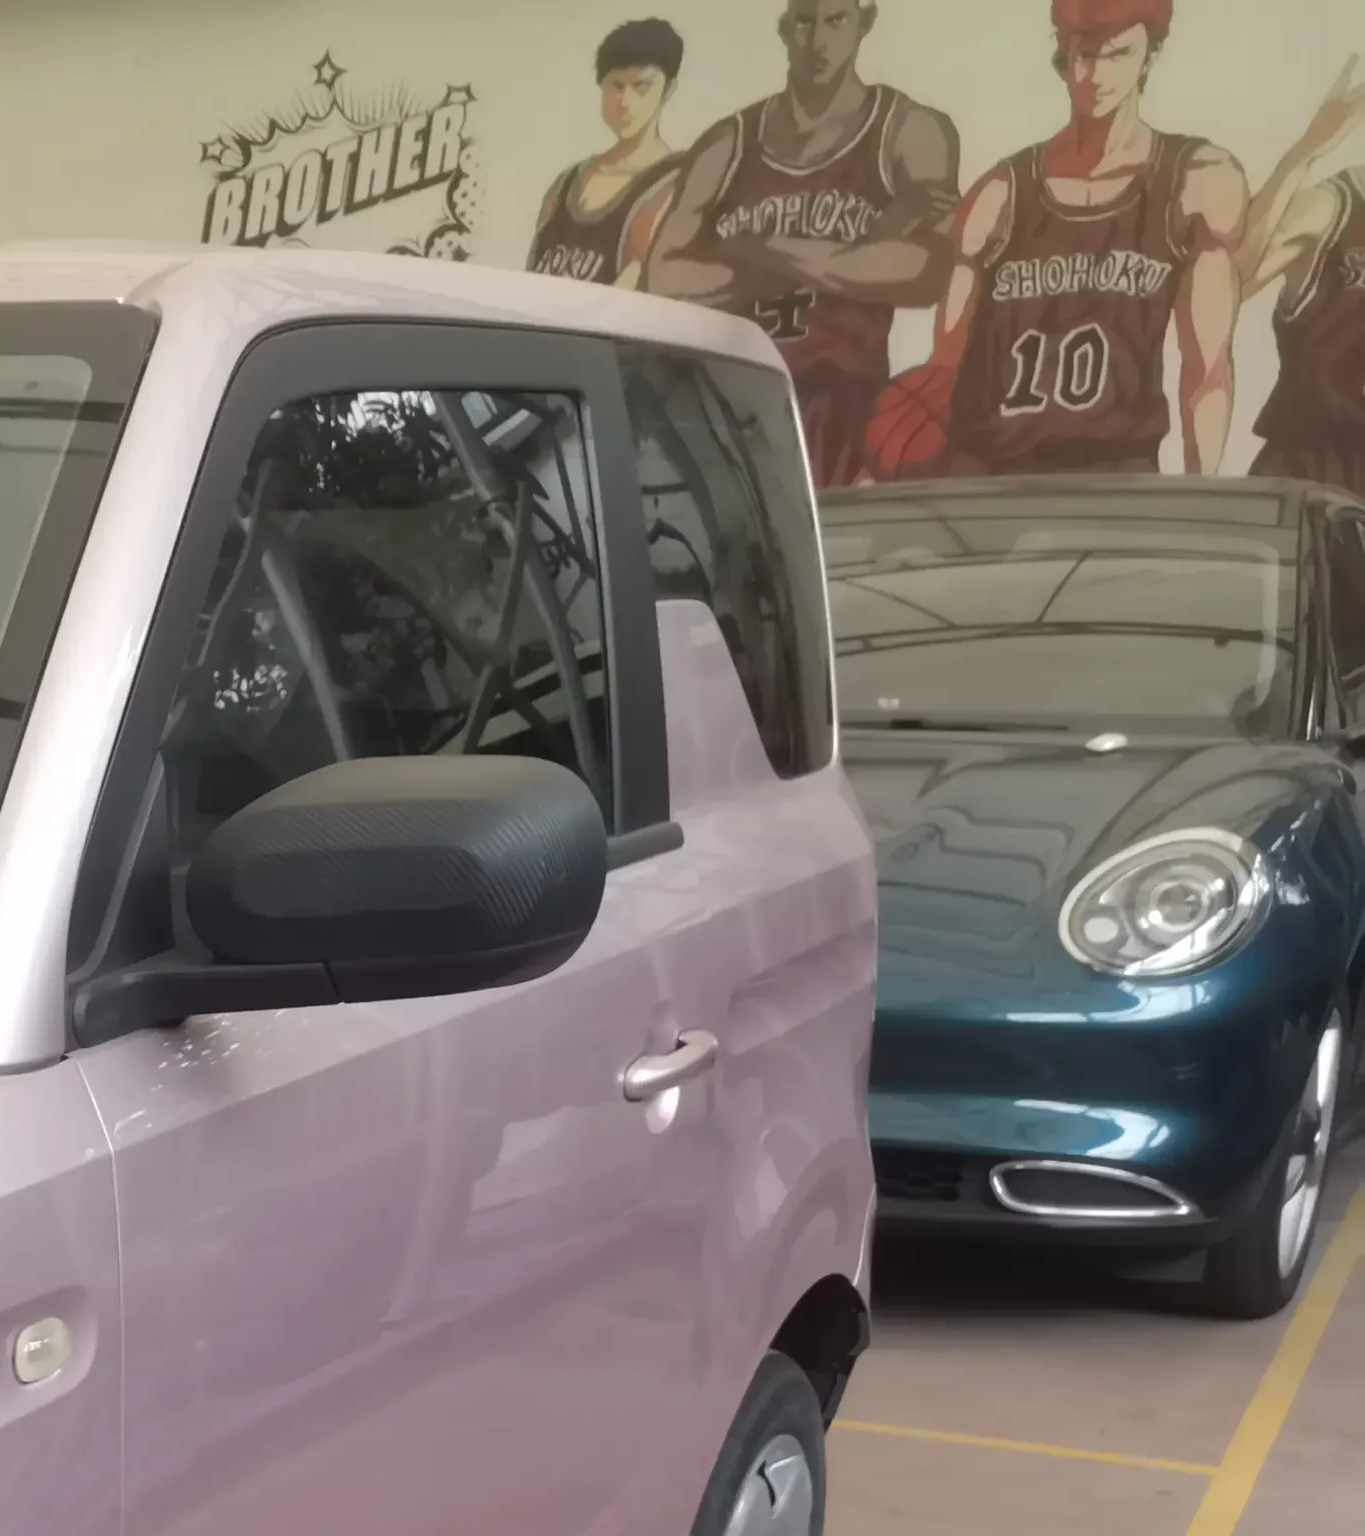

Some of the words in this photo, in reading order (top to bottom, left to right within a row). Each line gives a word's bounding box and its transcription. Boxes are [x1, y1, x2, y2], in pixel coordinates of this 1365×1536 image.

[201, 102, 466, 246] BROTHER
[991, 249, 1174, 302] SHOHOKU
[1000, 322, 1110, 417] 10
